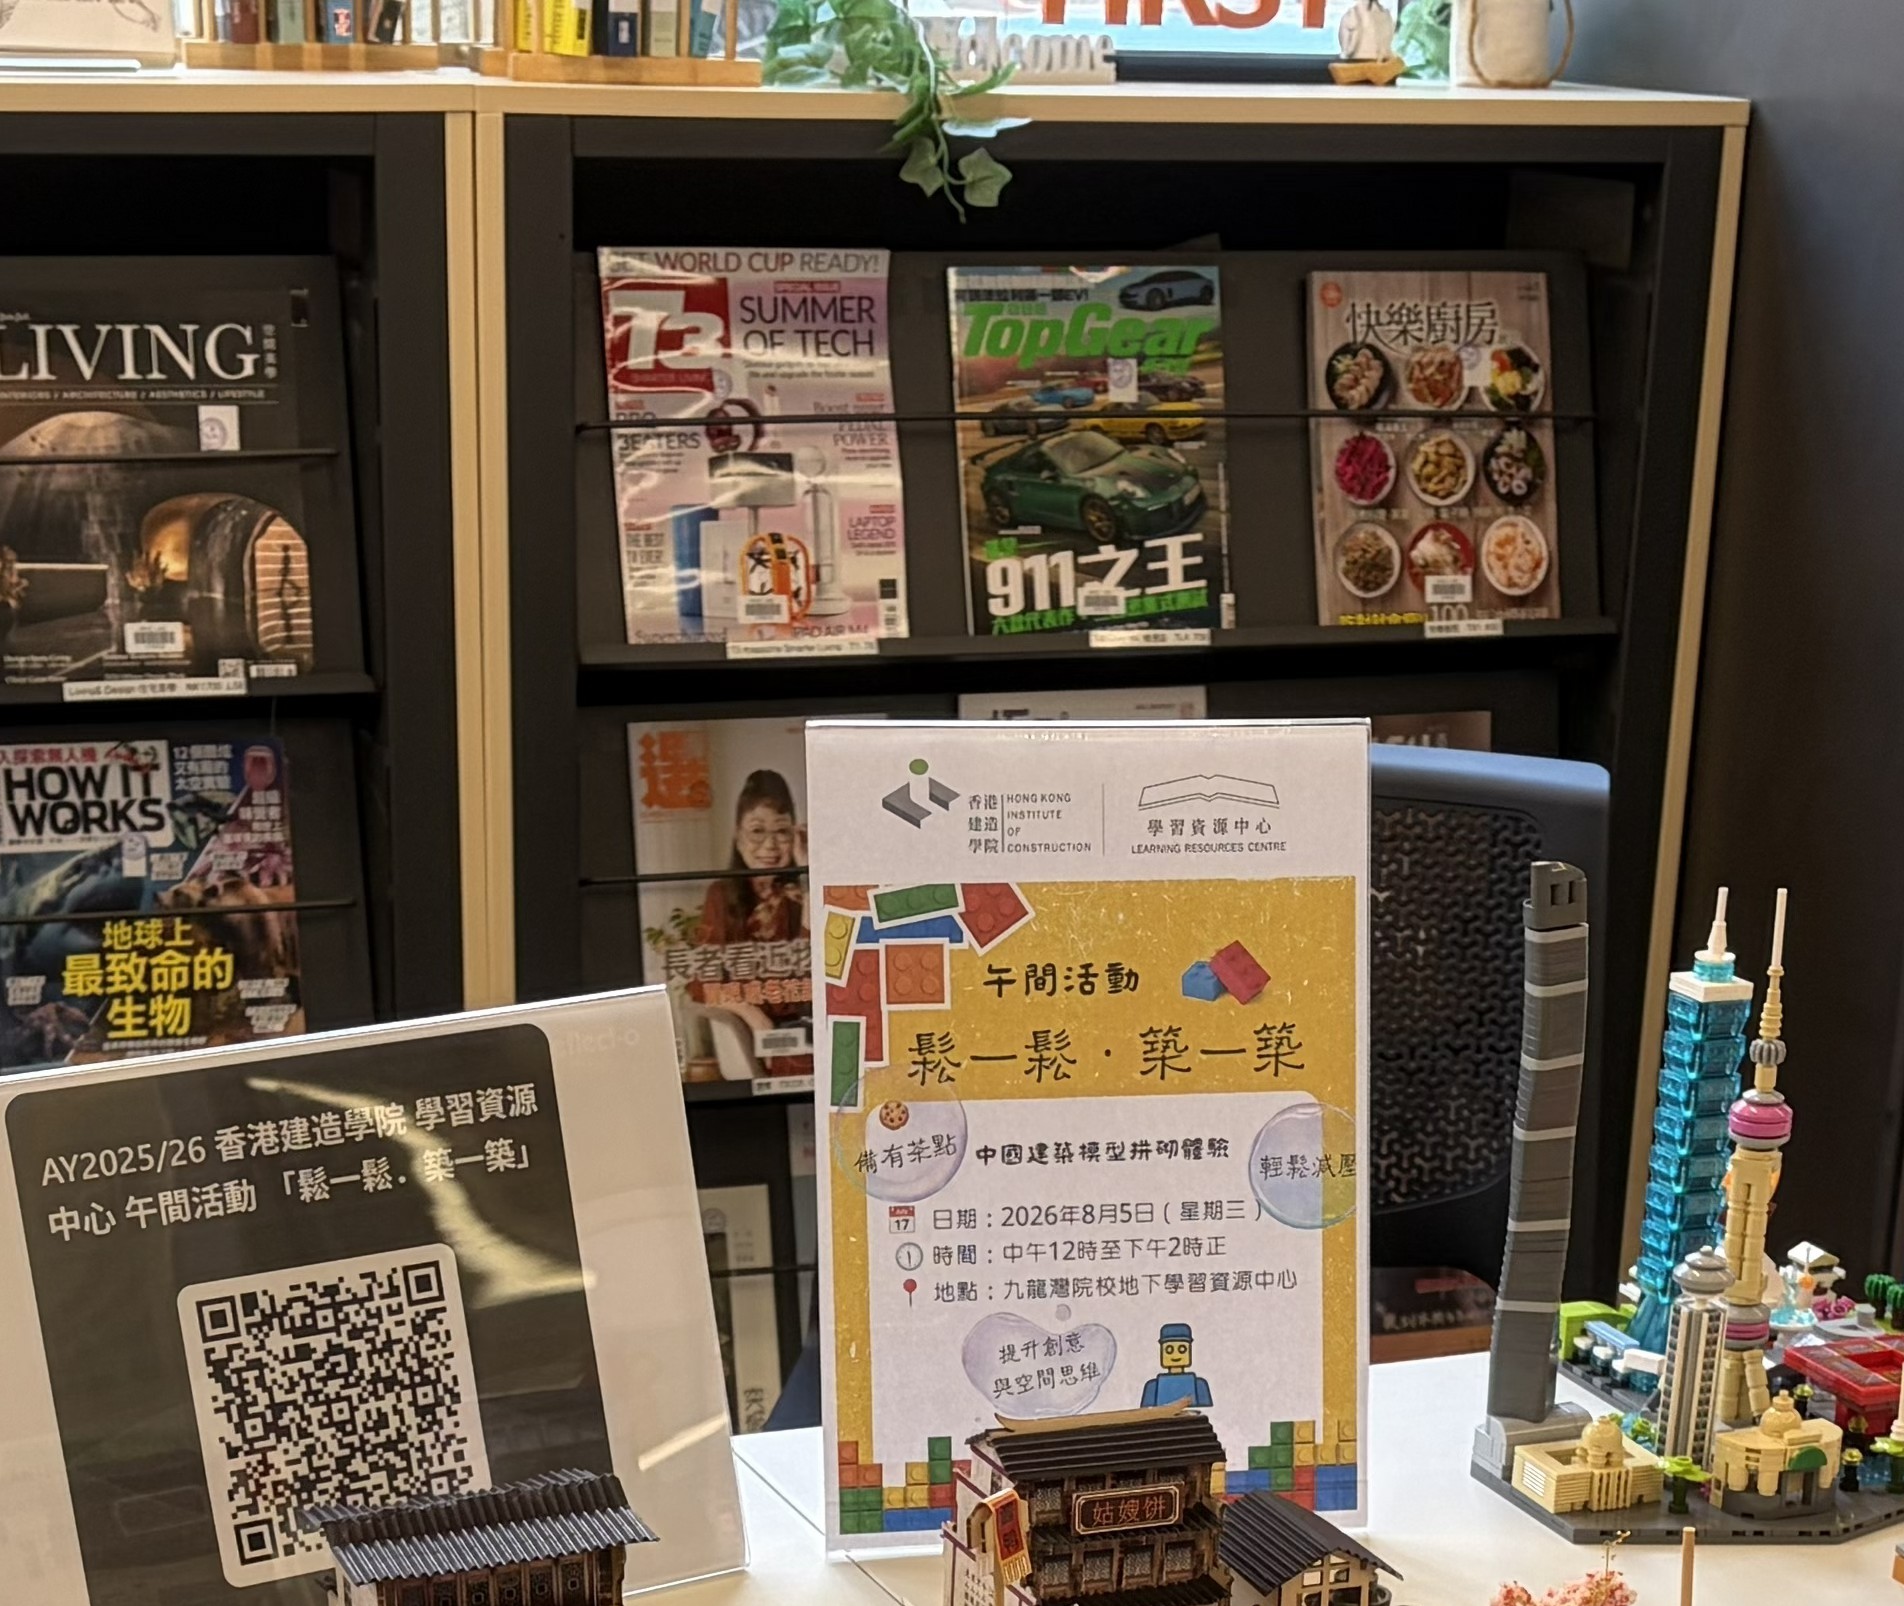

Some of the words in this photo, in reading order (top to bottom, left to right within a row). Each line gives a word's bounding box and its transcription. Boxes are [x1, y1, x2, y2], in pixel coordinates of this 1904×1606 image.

[655, 252, 742, 274] WORLD
[748, 251, 795, 273] CUP
[799, 253, 880, 274] READY!
[739, 296, 878, 325] SUMMER
[1346, 301, 1500, 352] 快樂廚房
[744, 330, 784, 357] OF
[793, 329, 875, 357] TECH
[961, 302, 1216, 370] TopGear
[985, 533, 1209, 617] 911之王
[4, 764, 114, 802] HOW
[120, 763, 162, 798] IT
[1006, 793, 1038, 804] HONG
[1040, 792, 1072, 803] KONG
[7, 798, 166, 837] WORKS
[968, 793, 999, 810] 香港
[1006, 809, 1063, 822] INSTITUTE
[968, 816, 999, 833] 建造
[1007, 826, 1022, 838] OF
[1146, 817, 1273, 838] 學習資源中心
[968, 838, 999, 855] 學院
[1006, 841, 1092, 855] CONSTRUCTION
[1130, 842, 1182, 856] LEARNING
[1184, 842, 1245, 855] RESOURCES
[1246, 841, 1288, 854] CENTRE
[102, 916, 195, 951] 地球上
[62, 947, 235, 997] 最致命的
[983, 961, 1140, 998] 午間活動
[106, 994, 193, 1040] 生物
[41, 1136, 207, 1187] AY2025/26
[214, 1102, 408, 1164] 香港建造學院
[415, 1082, 539, 1132] 學習資源
[854, 1132, 958, 1176] 備有茶點
[975, 1137, 1231, 1167] 中國建築模型拼砌體驗
[48, 1200, 117, 1242] 中心
[124, 1179, 257, 1231] 午間活動
[894, 1218, 910, 1231] 17
[998, 1332, 1086, 1365] 提升創意
[992, 1361, 1102, 1399] 與空間思維
[1091, 1495, 1167, 1528] 姑嫂饼
